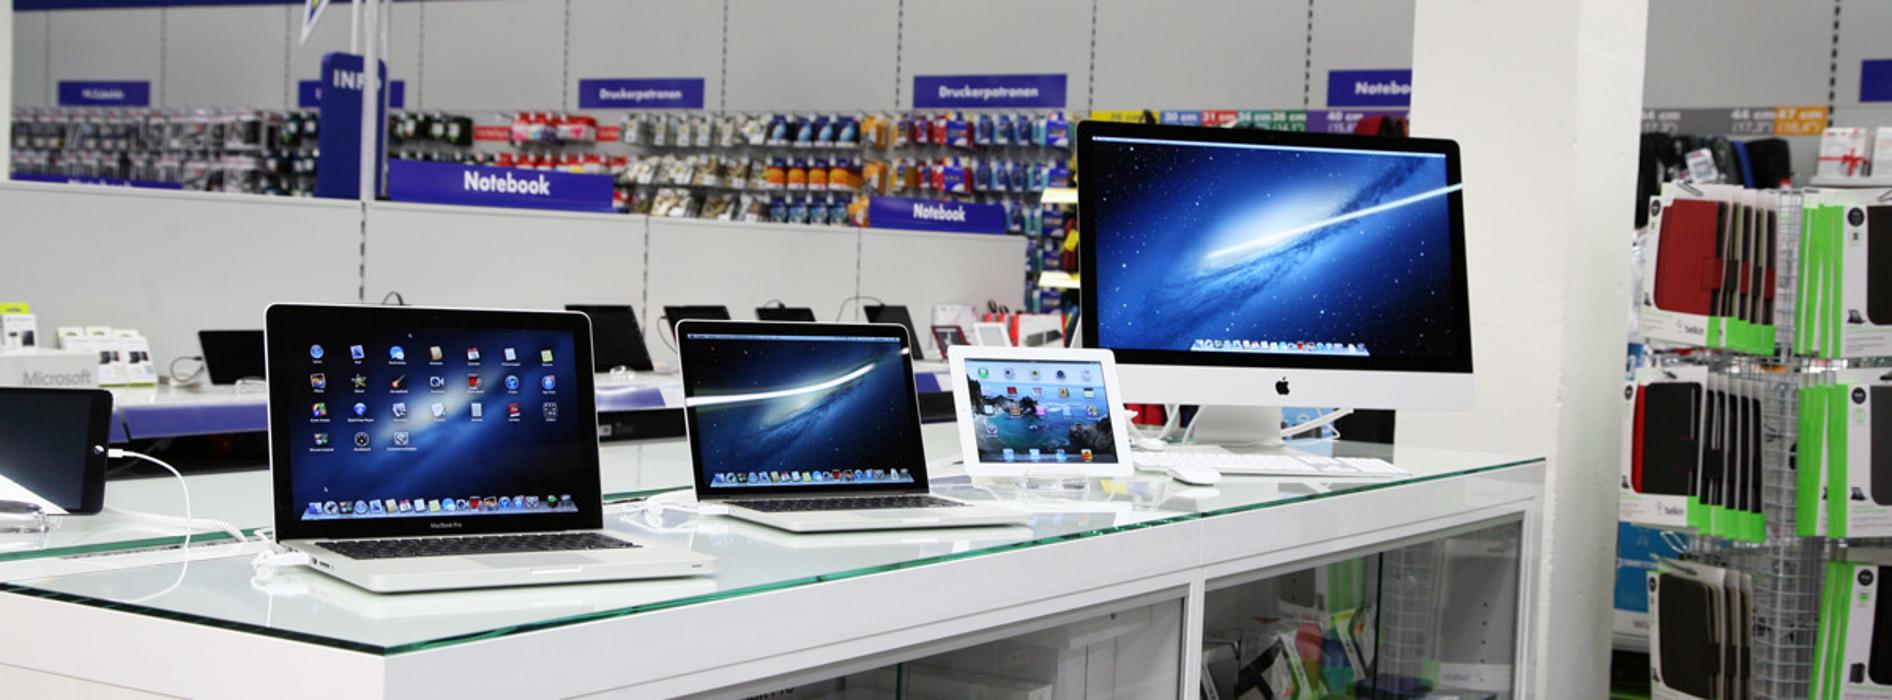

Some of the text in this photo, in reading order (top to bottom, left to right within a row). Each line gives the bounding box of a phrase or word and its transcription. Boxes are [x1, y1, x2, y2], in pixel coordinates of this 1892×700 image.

[332, 68, 381, 91] INF
[599, 87, 683, 103] Druckerpatronen
[938, 84, 1039, 101] Druckerpatronen
[1658, 111, 1681, 121] cm
[464, 169, 551, 196] Notebook
[913, 202, 966, 222] Notebook
[23, 369, 92, 386] Microsoft
